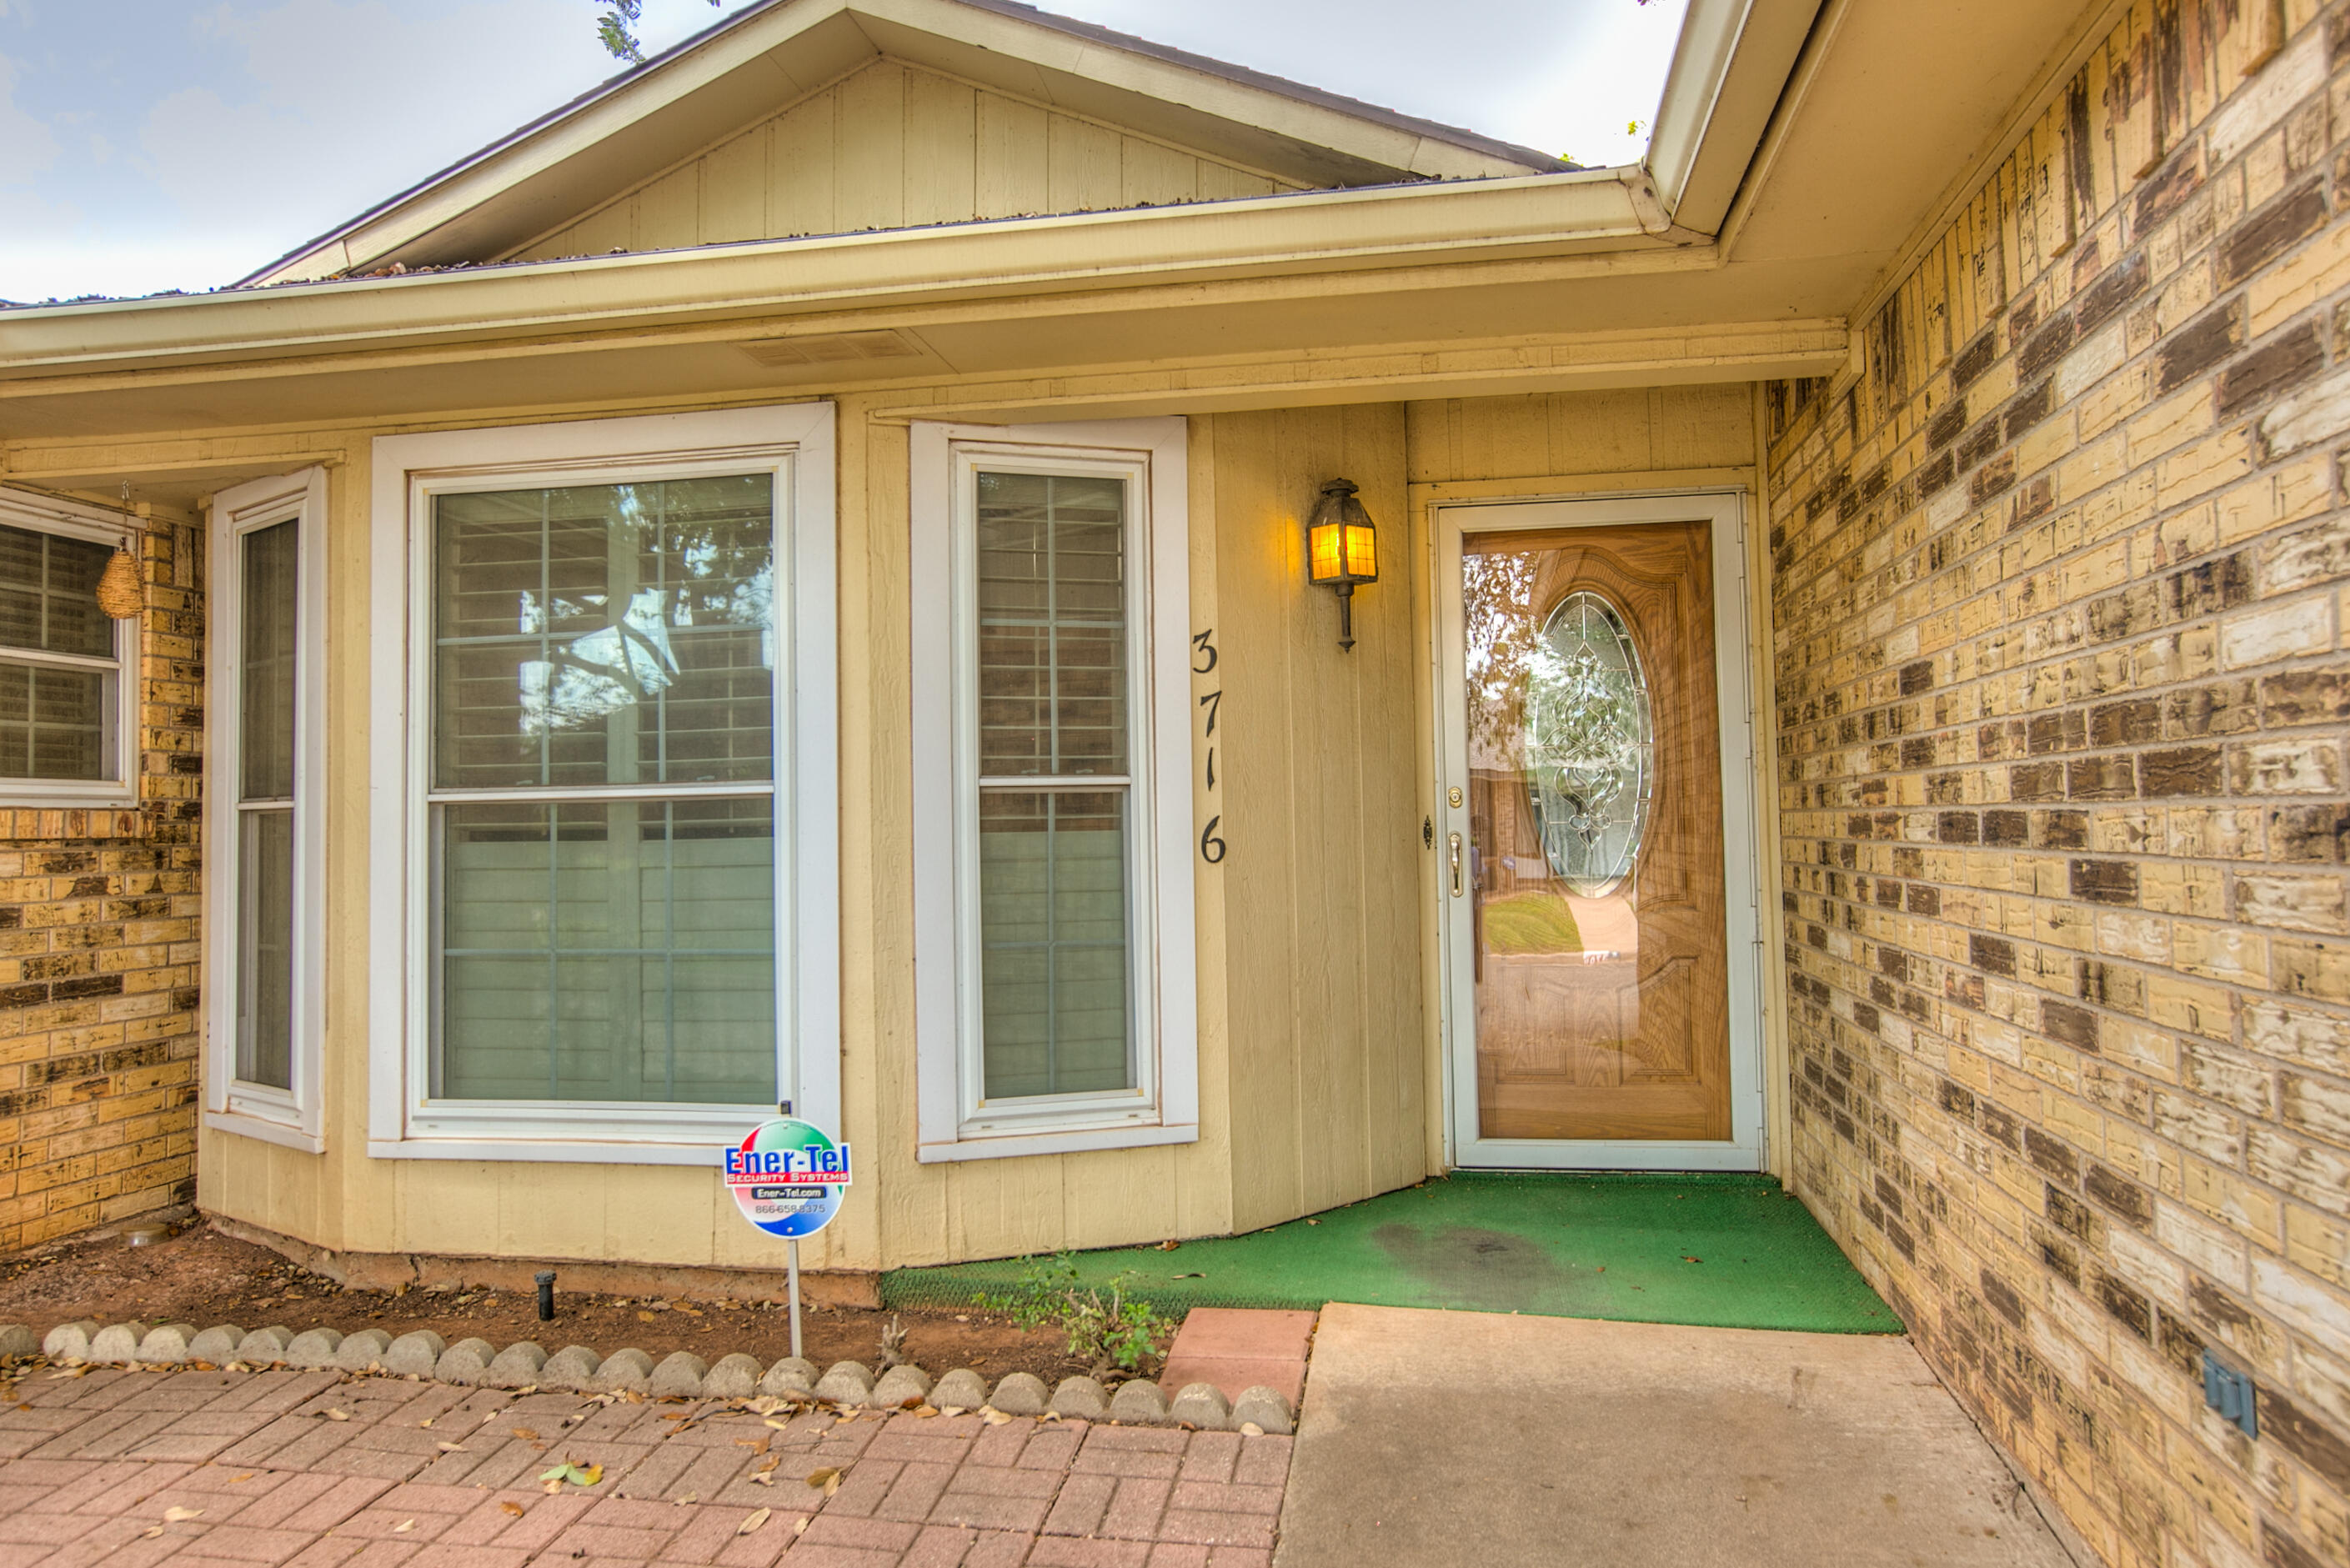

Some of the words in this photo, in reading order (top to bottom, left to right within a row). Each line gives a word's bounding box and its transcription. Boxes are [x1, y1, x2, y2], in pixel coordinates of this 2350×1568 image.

[1192, 629, 1226, 864] 3716
[725, 1145, 849, 1174] Ener-Tel
[728, 1174, 785, 1182] SECURITY
[791, 1173, 848, 1181] SYSTEMS
[757, 1188, 821, 1198] Ener-Tel.com
